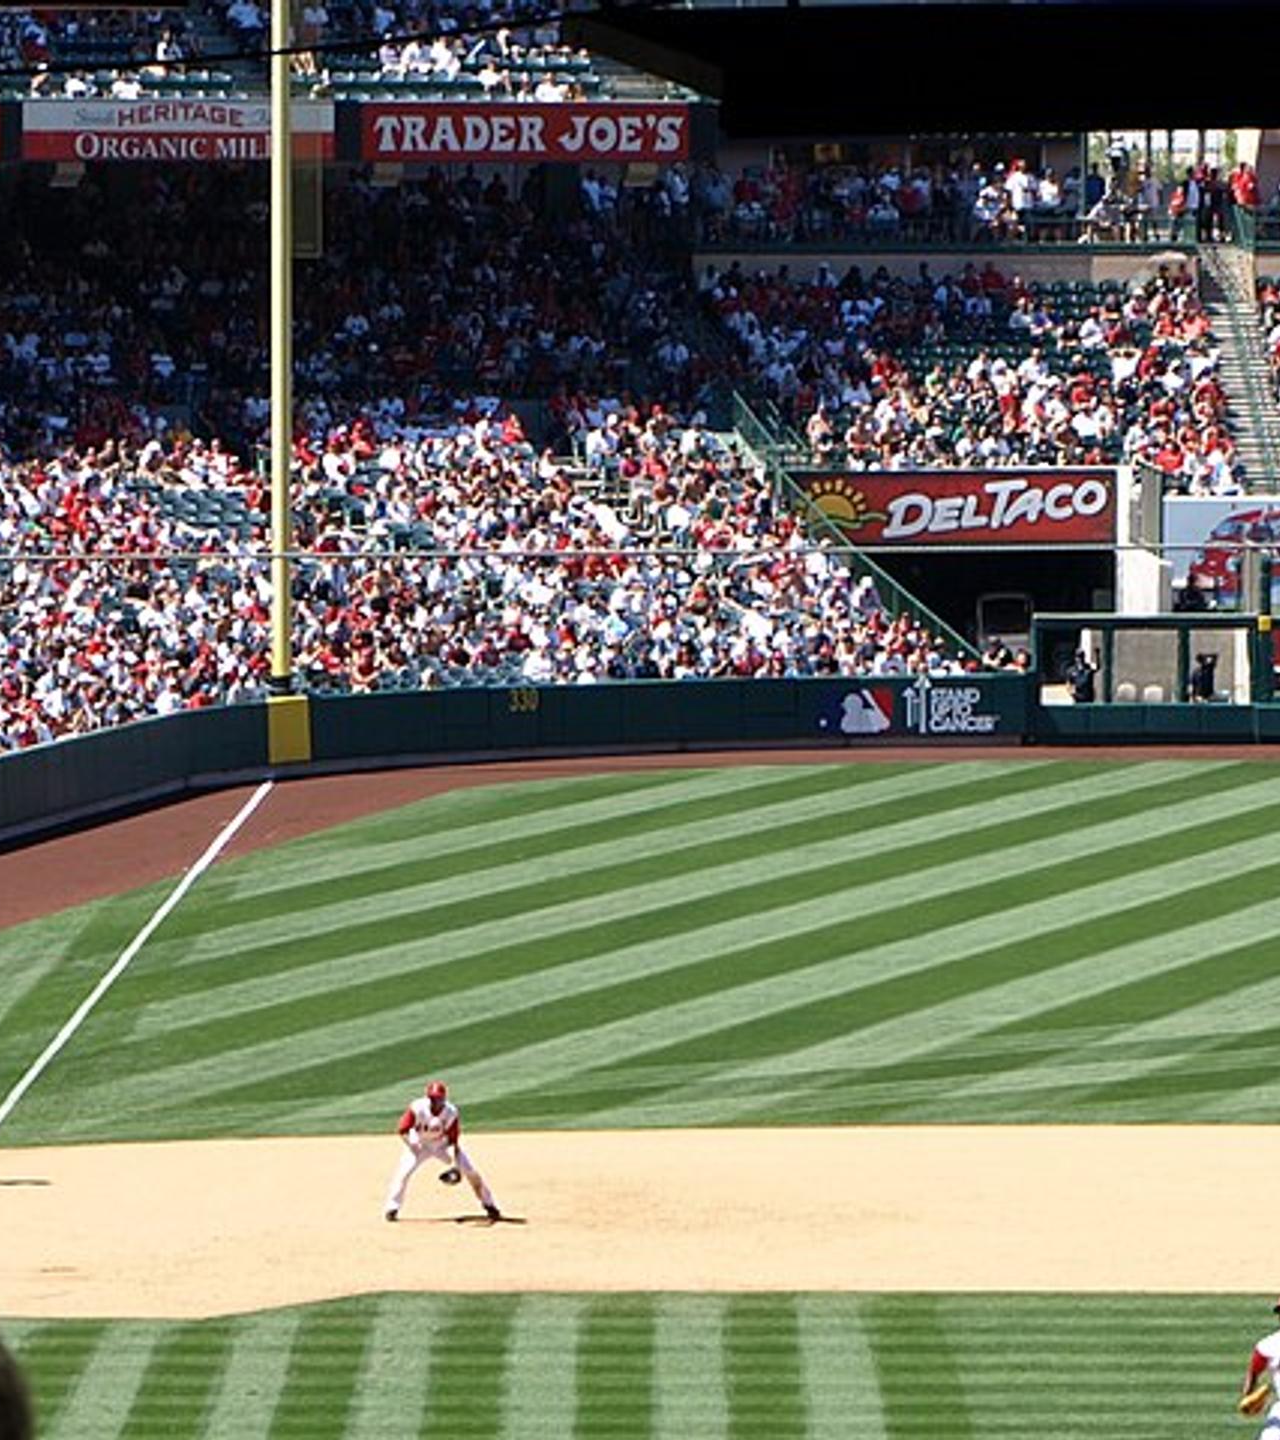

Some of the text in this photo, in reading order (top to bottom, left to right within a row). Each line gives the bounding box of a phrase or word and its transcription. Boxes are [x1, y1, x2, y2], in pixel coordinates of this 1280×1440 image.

[117, 104, 244, 128] HERITAGE
[372, 113, 686, 152] TRADER JOE'S
[74, 132, 209, 159] ORGANIC
[931, 687, 981, 703] STAND
[929, 715, 995, 733] CANCER
